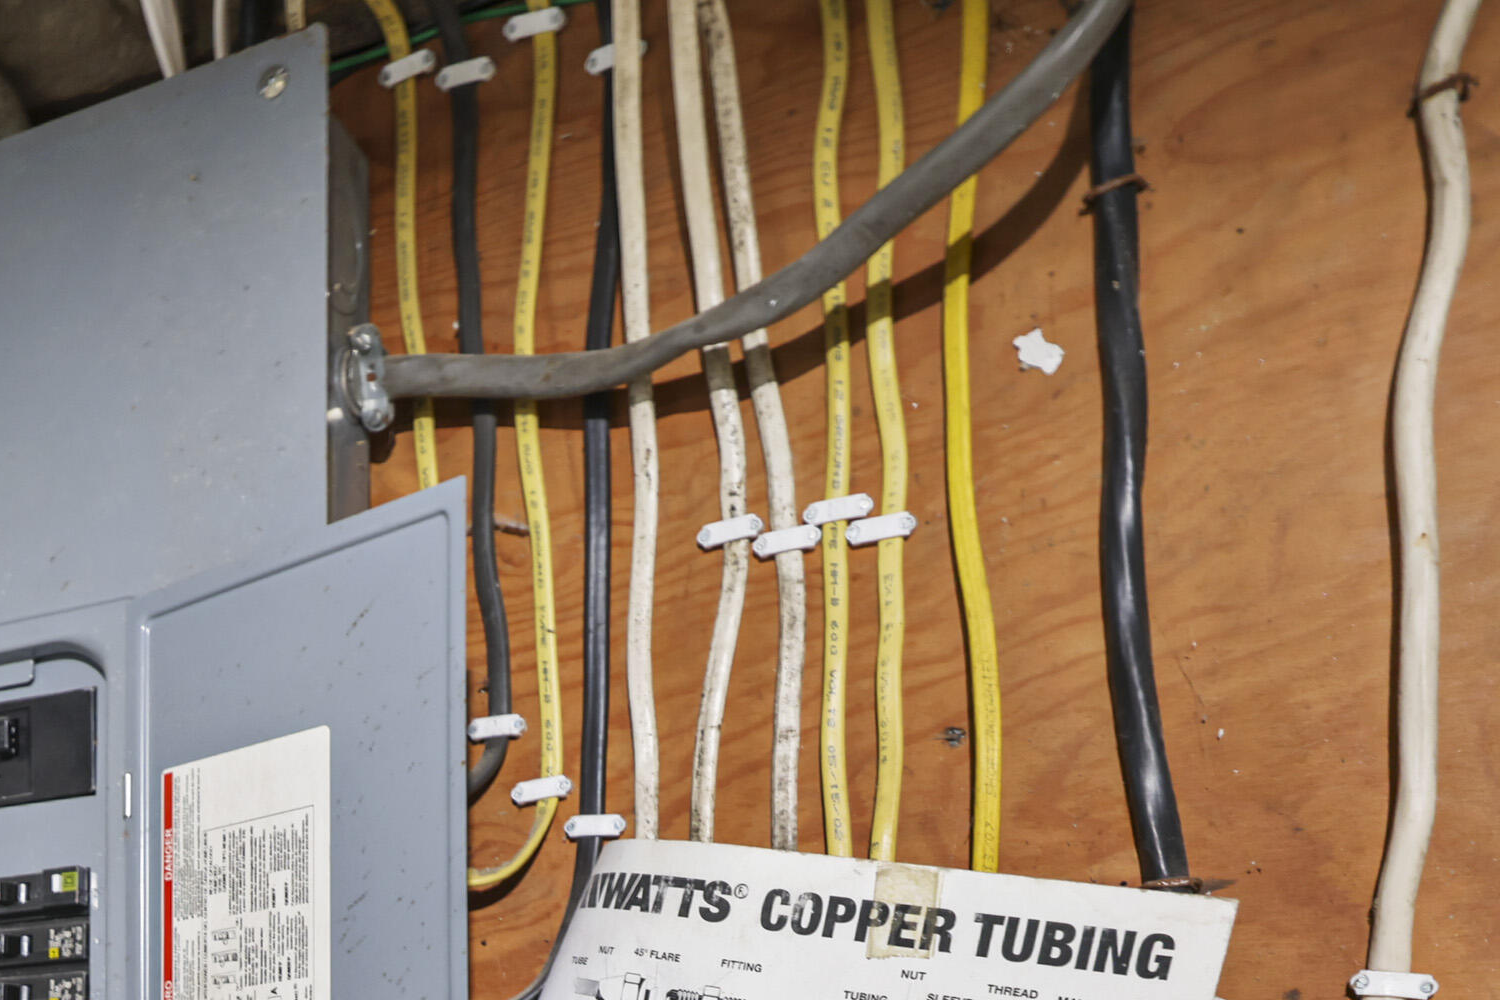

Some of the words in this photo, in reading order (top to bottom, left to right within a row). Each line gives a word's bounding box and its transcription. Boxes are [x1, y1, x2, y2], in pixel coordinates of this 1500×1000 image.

[164, 828, 173, 881] DANGER
[760, 888, 957, 954] COPPER
[973, 912, 1176, 981] TUBING
[598, 945, 616, 956] NUT
[649, 949, 682, 963] FLARE
[720, 958, 763, 974] FITTING
[900, 969, 927, 981] NUT
[987, 983, 1039, 1000] THREAD
